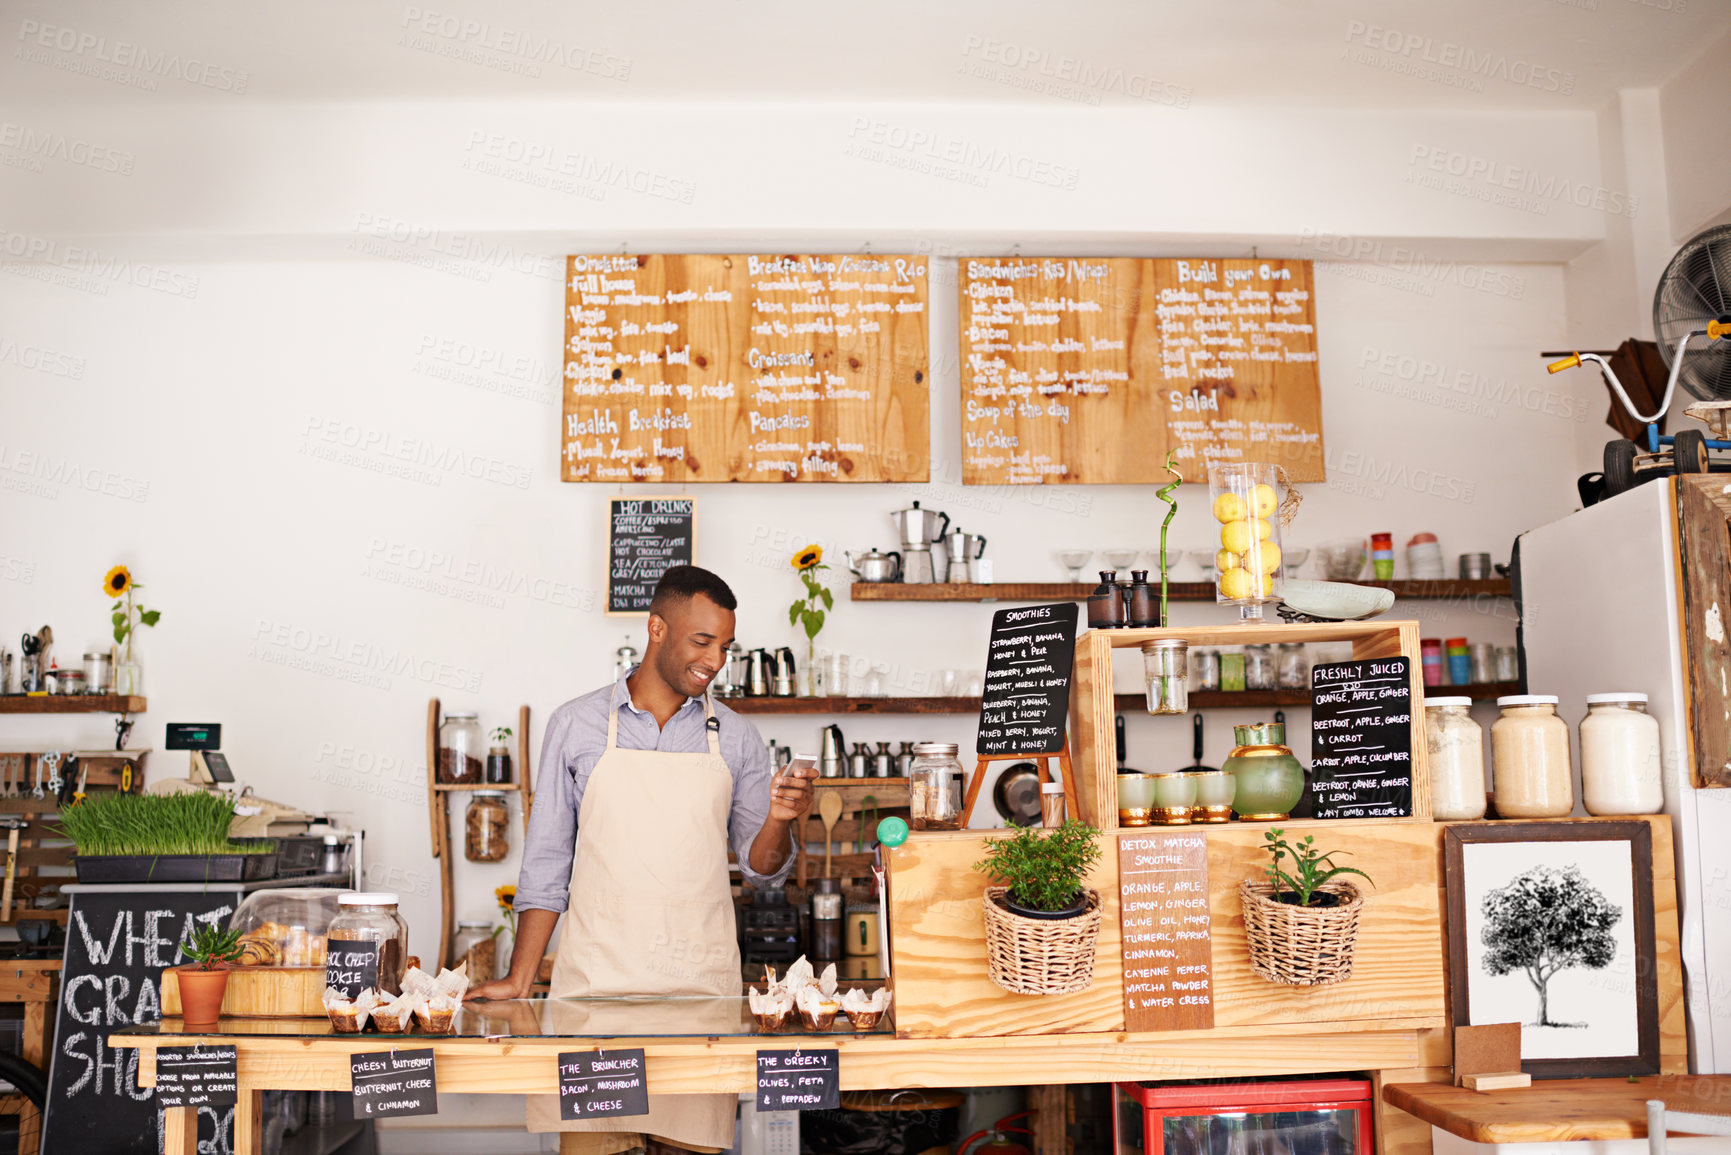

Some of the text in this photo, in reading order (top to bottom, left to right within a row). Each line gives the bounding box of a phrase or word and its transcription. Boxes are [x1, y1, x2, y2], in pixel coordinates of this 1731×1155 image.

[1177, 261, 1291, 288] Build your Own
[969, 281, 1014, 299] Chicken
[969, 326, 1008, 342] Bacon
[749, 347, 814, 368] Croissant
[567, 362, 611, 380] Chicken
[1169, 389, 1218, 413] Salad
[967, 398, 1069, 425] Soup of the day
[567, 408, 692, 436] Health Breakfast
[750, 409, 809, 434] Pancakes
[986, 429, 1018, 448] Cakes
[653, 438, 684, 460] Honey
[621, 501, 692, 515] HOT DRINKS
[615, 547, 630, 556] HOT
[614, 586, 645, 595] MATCHA
[1006, 608, 1051, 623] SMOOTHIES
[994, 650, 1015, 660] HONEY
[1021, 649, 1026, 658] &
[1314, 662, 1404, 682] FRESHLY JUICED
[1040, 679, 1045, 687] &
[1046, 678, 1067, 687] HONEY
[1379, 688, 1408, 698] GINGER
[984, 710, 1046, 724] PEACH & HONEY
[1385, 715, 1409, 725] GINGER
[979, 728, 1001, 738] MIXED
[1329, 734, 1363, 744] CARROT
[986, 740, 1047, 750] MINT & HONEY
[1369, 752, 1409, 762] CUCUMBER
[1381, 777, 1409, 787] GINGER
[1329, 792, 1356, 801] LEMON
[1324, 807, 1397, 818] ANY COMBO WELCOME
[1121, 838, 1204, 851] DETOX MATCHA
[1135, 855, 1183, 866] SMOOTHIE
[1124, 918, 1152, 927] OLIVE
[73, 905, 233, 967] WHEAT
[326, 952, 374, 967] HOC CHIP
[326, 970, 361, 984] OOKIE
[1125, 966, 1169, 978] CAYENNE
[1126, 980, 1208, 994] MATCHA POWDER
[64, 974, 162, 1026] GRA
[1129, 996, 1210, 1009] & WATER CRESS
[352, 1058, 432, 1073] CHEESY BUTTERNUT
[560, 1058, 639, 1075] THE BRUNCHER
[758, 1056, 827, 1066] THE GREEKY
[406, 1079, 431, 1088] CHEESE
[598, 1078, 639, 1090] MUSHROOM
[798, 1077, 824, 1086] FETA
[366, 1100, 420, 1112] & CINNAMON
[764, 1095, 821, 1104] & PEPPADEW
[574, 1100, 623, 1114] & CHEESE
